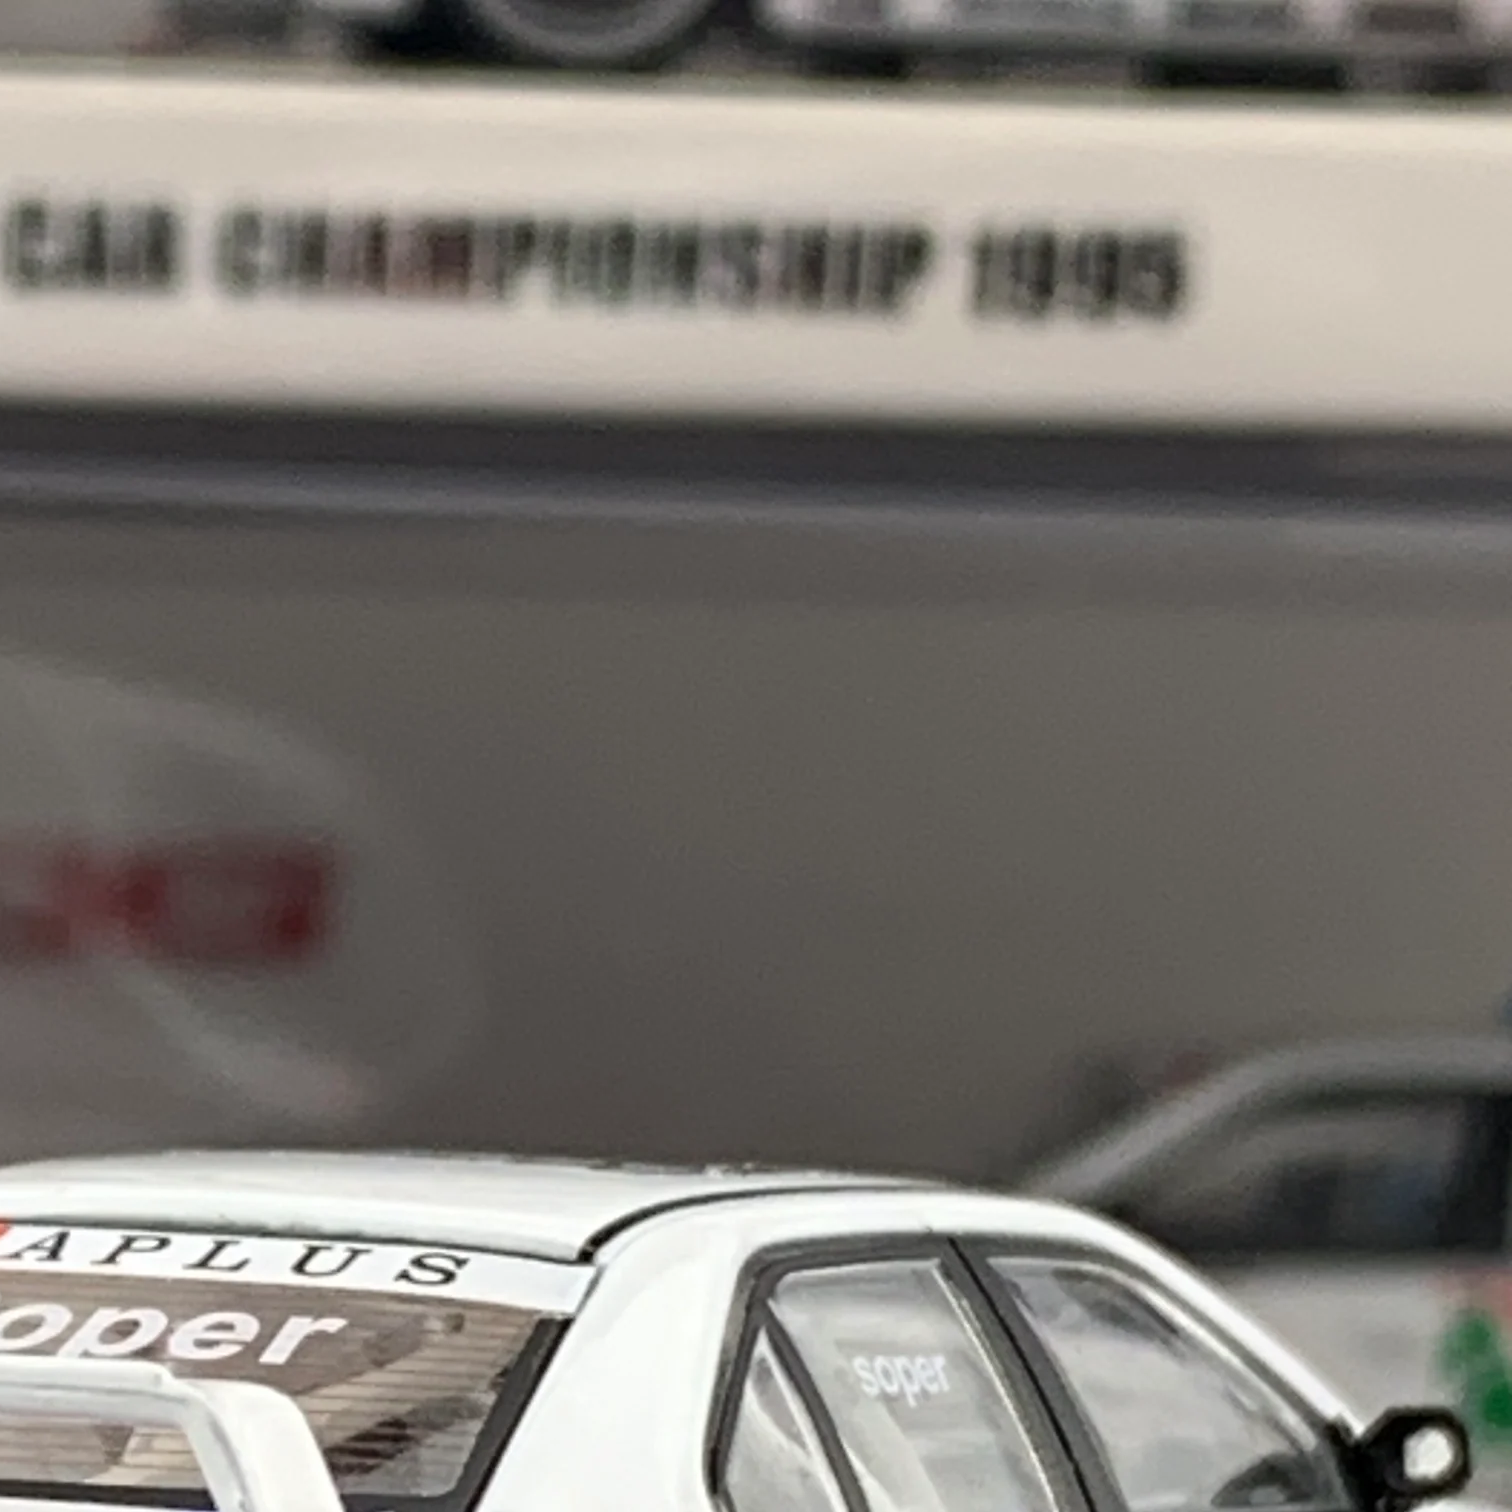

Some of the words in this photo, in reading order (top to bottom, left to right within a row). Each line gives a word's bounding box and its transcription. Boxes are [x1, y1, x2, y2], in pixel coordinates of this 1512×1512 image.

[4, 203, 174, 295] CAR
[216, 208, 931, 316] CHAMPIONSHIP
[5, 1232, 471, 1288] APLUS
